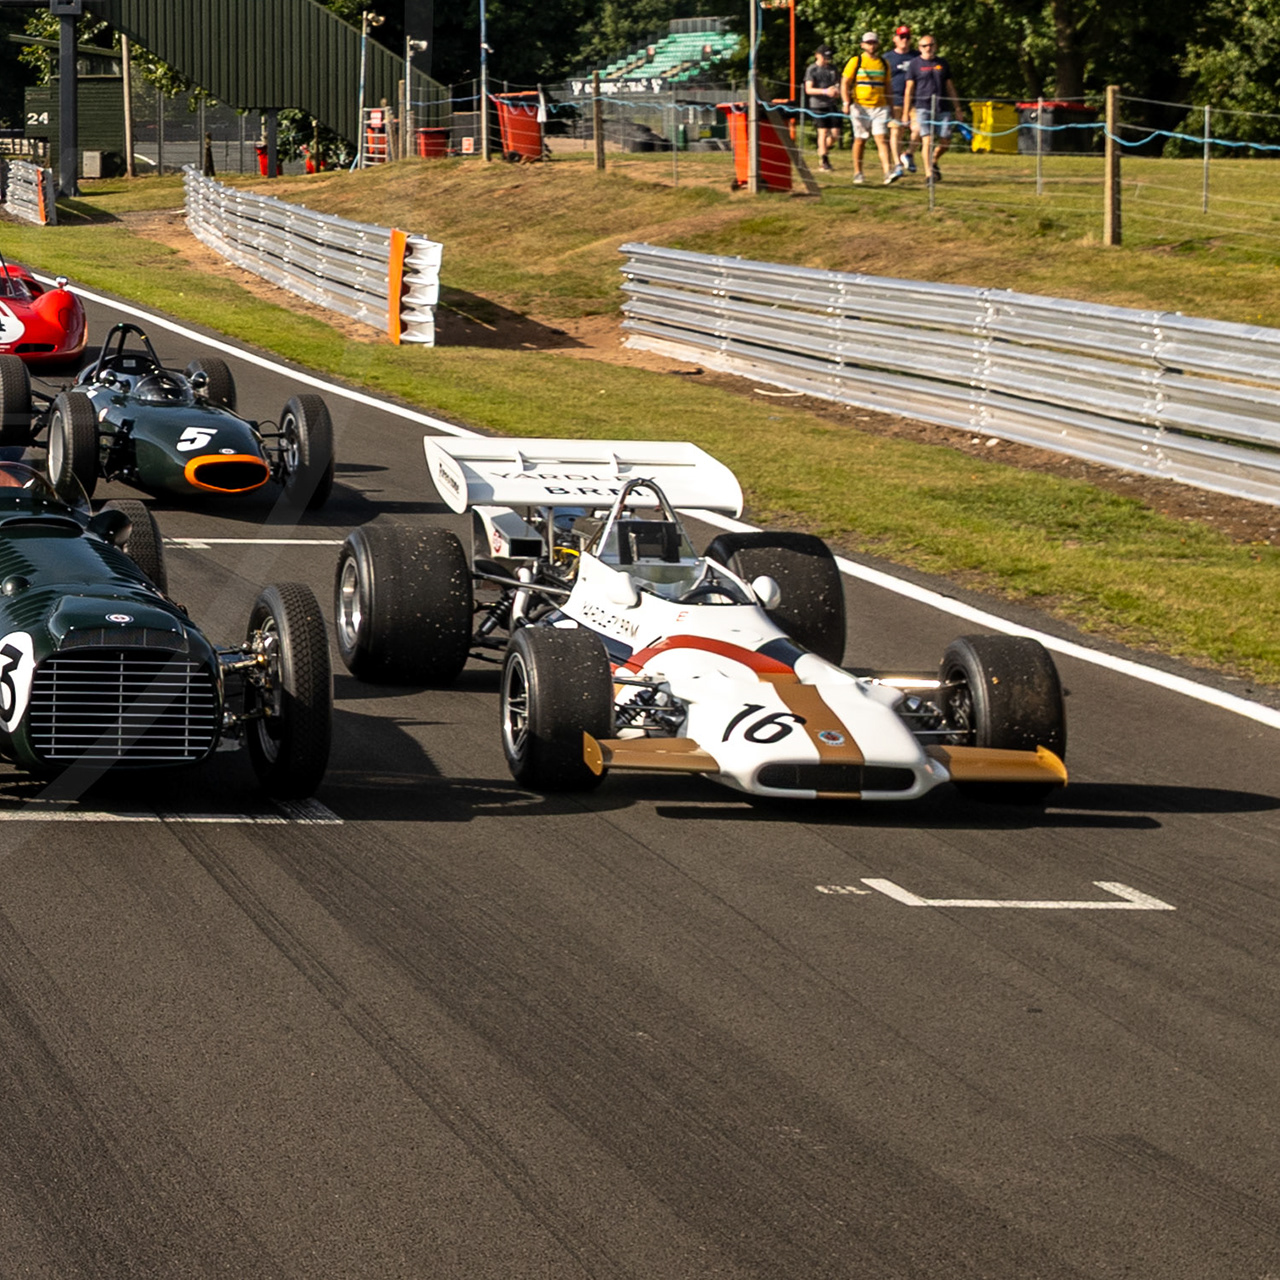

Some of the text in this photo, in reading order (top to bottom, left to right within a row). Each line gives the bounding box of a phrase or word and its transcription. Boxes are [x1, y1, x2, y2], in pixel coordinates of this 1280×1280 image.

[27, 112, 49, 125] 24
[176, 426, 219, 452] 5
[490, 472, 657, 483] YARDLEY
[722, 703, 807, 744] 16
